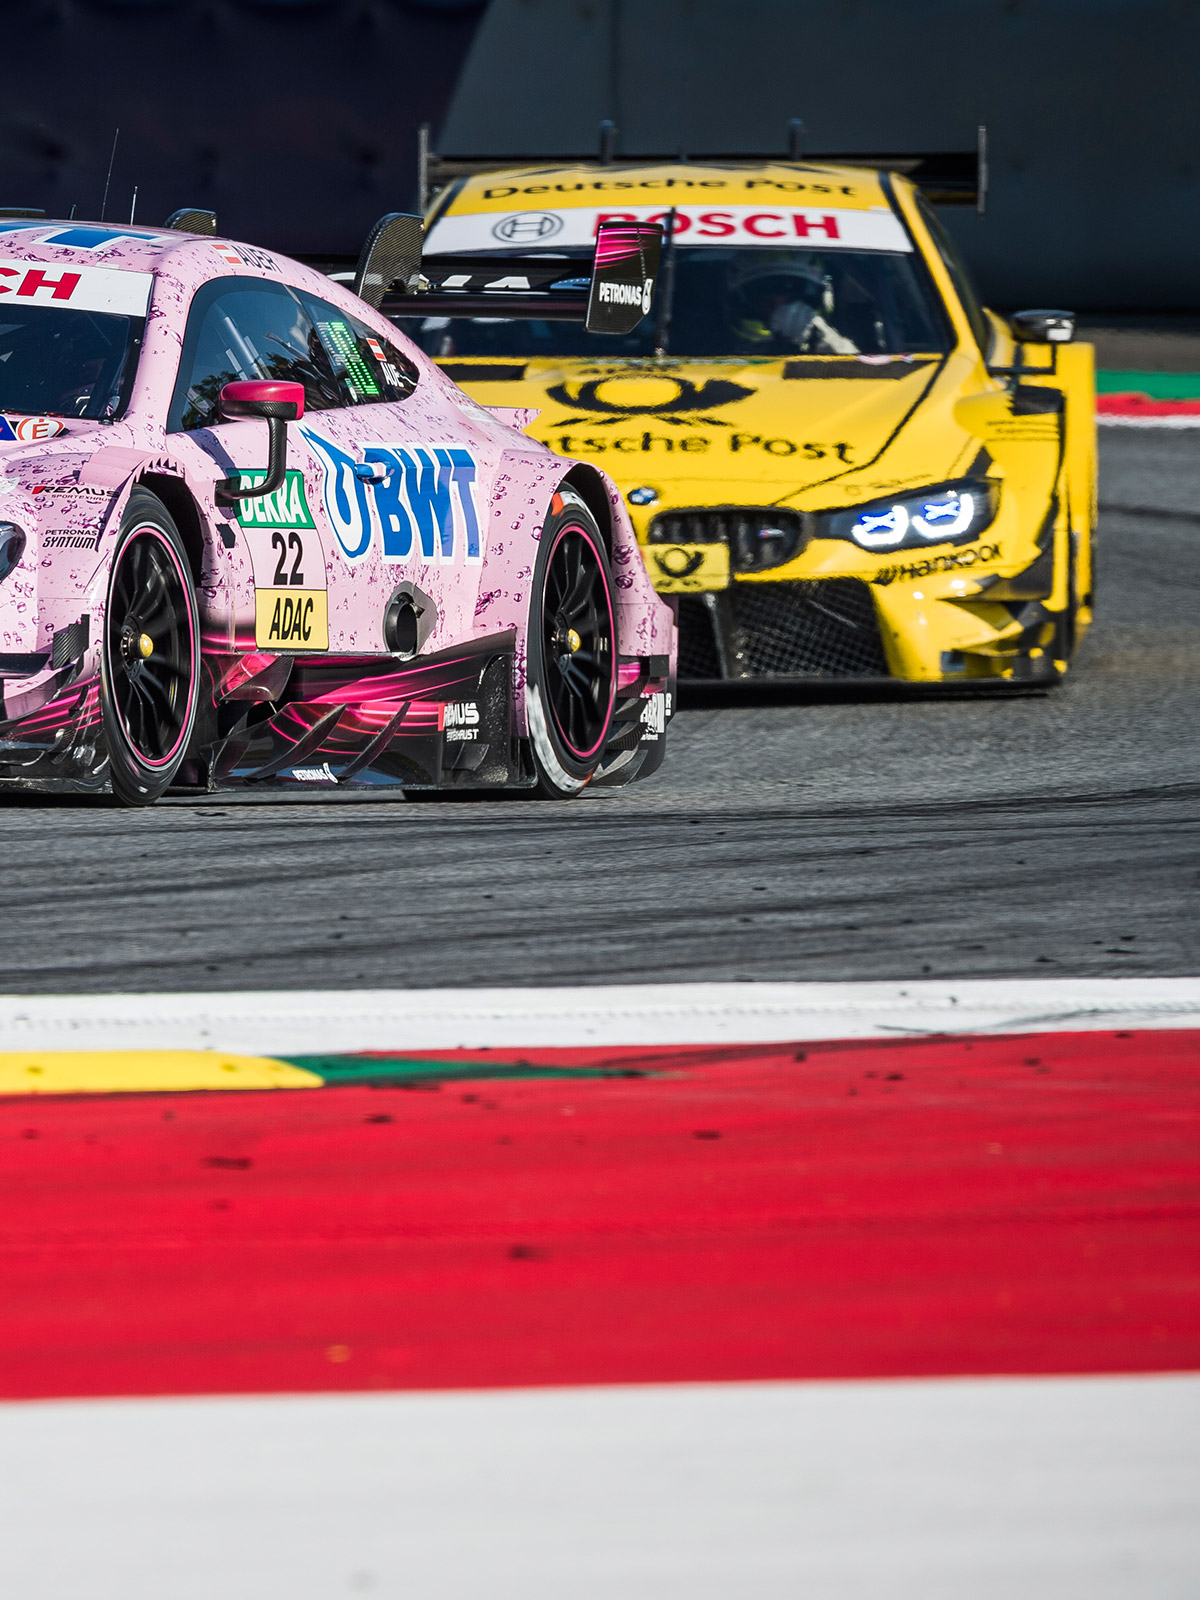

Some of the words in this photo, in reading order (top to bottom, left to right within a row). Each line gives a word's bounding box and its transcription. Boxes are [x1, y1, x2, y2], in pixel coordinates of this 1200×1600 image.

[483, 178, 727, 199] Deutsche
[745, 179, 857, 197] Post
[231, 245, 282, 273] AUER
[600, 282, 642, 307] PETRONAS
[541, 432, 711, 454] tsche
[729, 433, 855, 465] Post
[38, 486, 120, 498] REMUS
[239, 475, 308, 524] DEKRA
[363, 446, 481, 558] BWT
[42, 536, 96, 549] SYNTIUM
[271, 532, 304, 586] 22
[269, 597, 314, 642] ADAC
